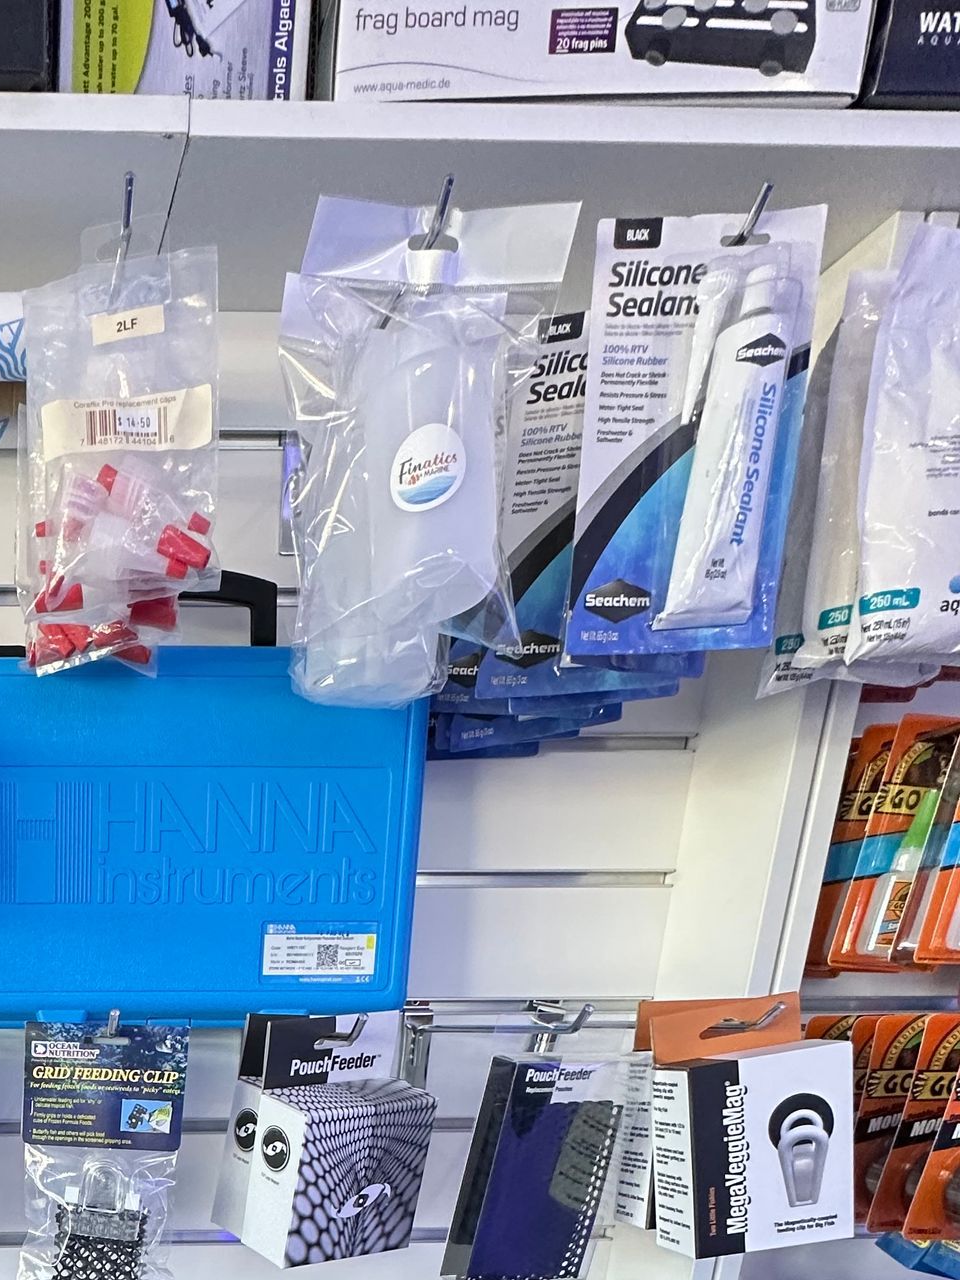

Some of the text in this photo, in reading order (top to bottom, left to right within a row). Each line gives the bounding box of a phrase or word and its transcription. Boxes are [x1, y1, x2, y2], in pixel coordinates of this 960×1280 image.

[355, 6, 519, 34] frag board mag
[556, 36, 608, 52] 20 frag pins
[353, 78, 451, 94] www.aqua-medic.de
[627, 228, 649, 241] BLACK
[609, 261, 708, 288] Silicone
[117, 318, 138, 332] 2LF
[603, 344, 648, 354] 100% RTV
[602, 356, 668, 367] Silicone Rubber
[116, 397, 158, 408] replacement
[161, 396, 176, 406] caps
[399, 452, 457, 486] Finatics
[424, 465, 450, 476] MARINE
[728, 382, 777, 546] Silicone Sealant
[585, 594, 650, 607] Seachem
[99, 781, 377, 854] HANNA
[98, 856, 376, 905] instruments
[49, 1050, 96, 1058] NUTRITION
[290, 1054, 377, 1077] PouchFeeder
[32, 1066, 179, 1084] GRID FEEDING CLIP
[525, 1068, 592, 1083] PouchFeeder
[723, 1084, 751, 1235] MegaVeggieMag
